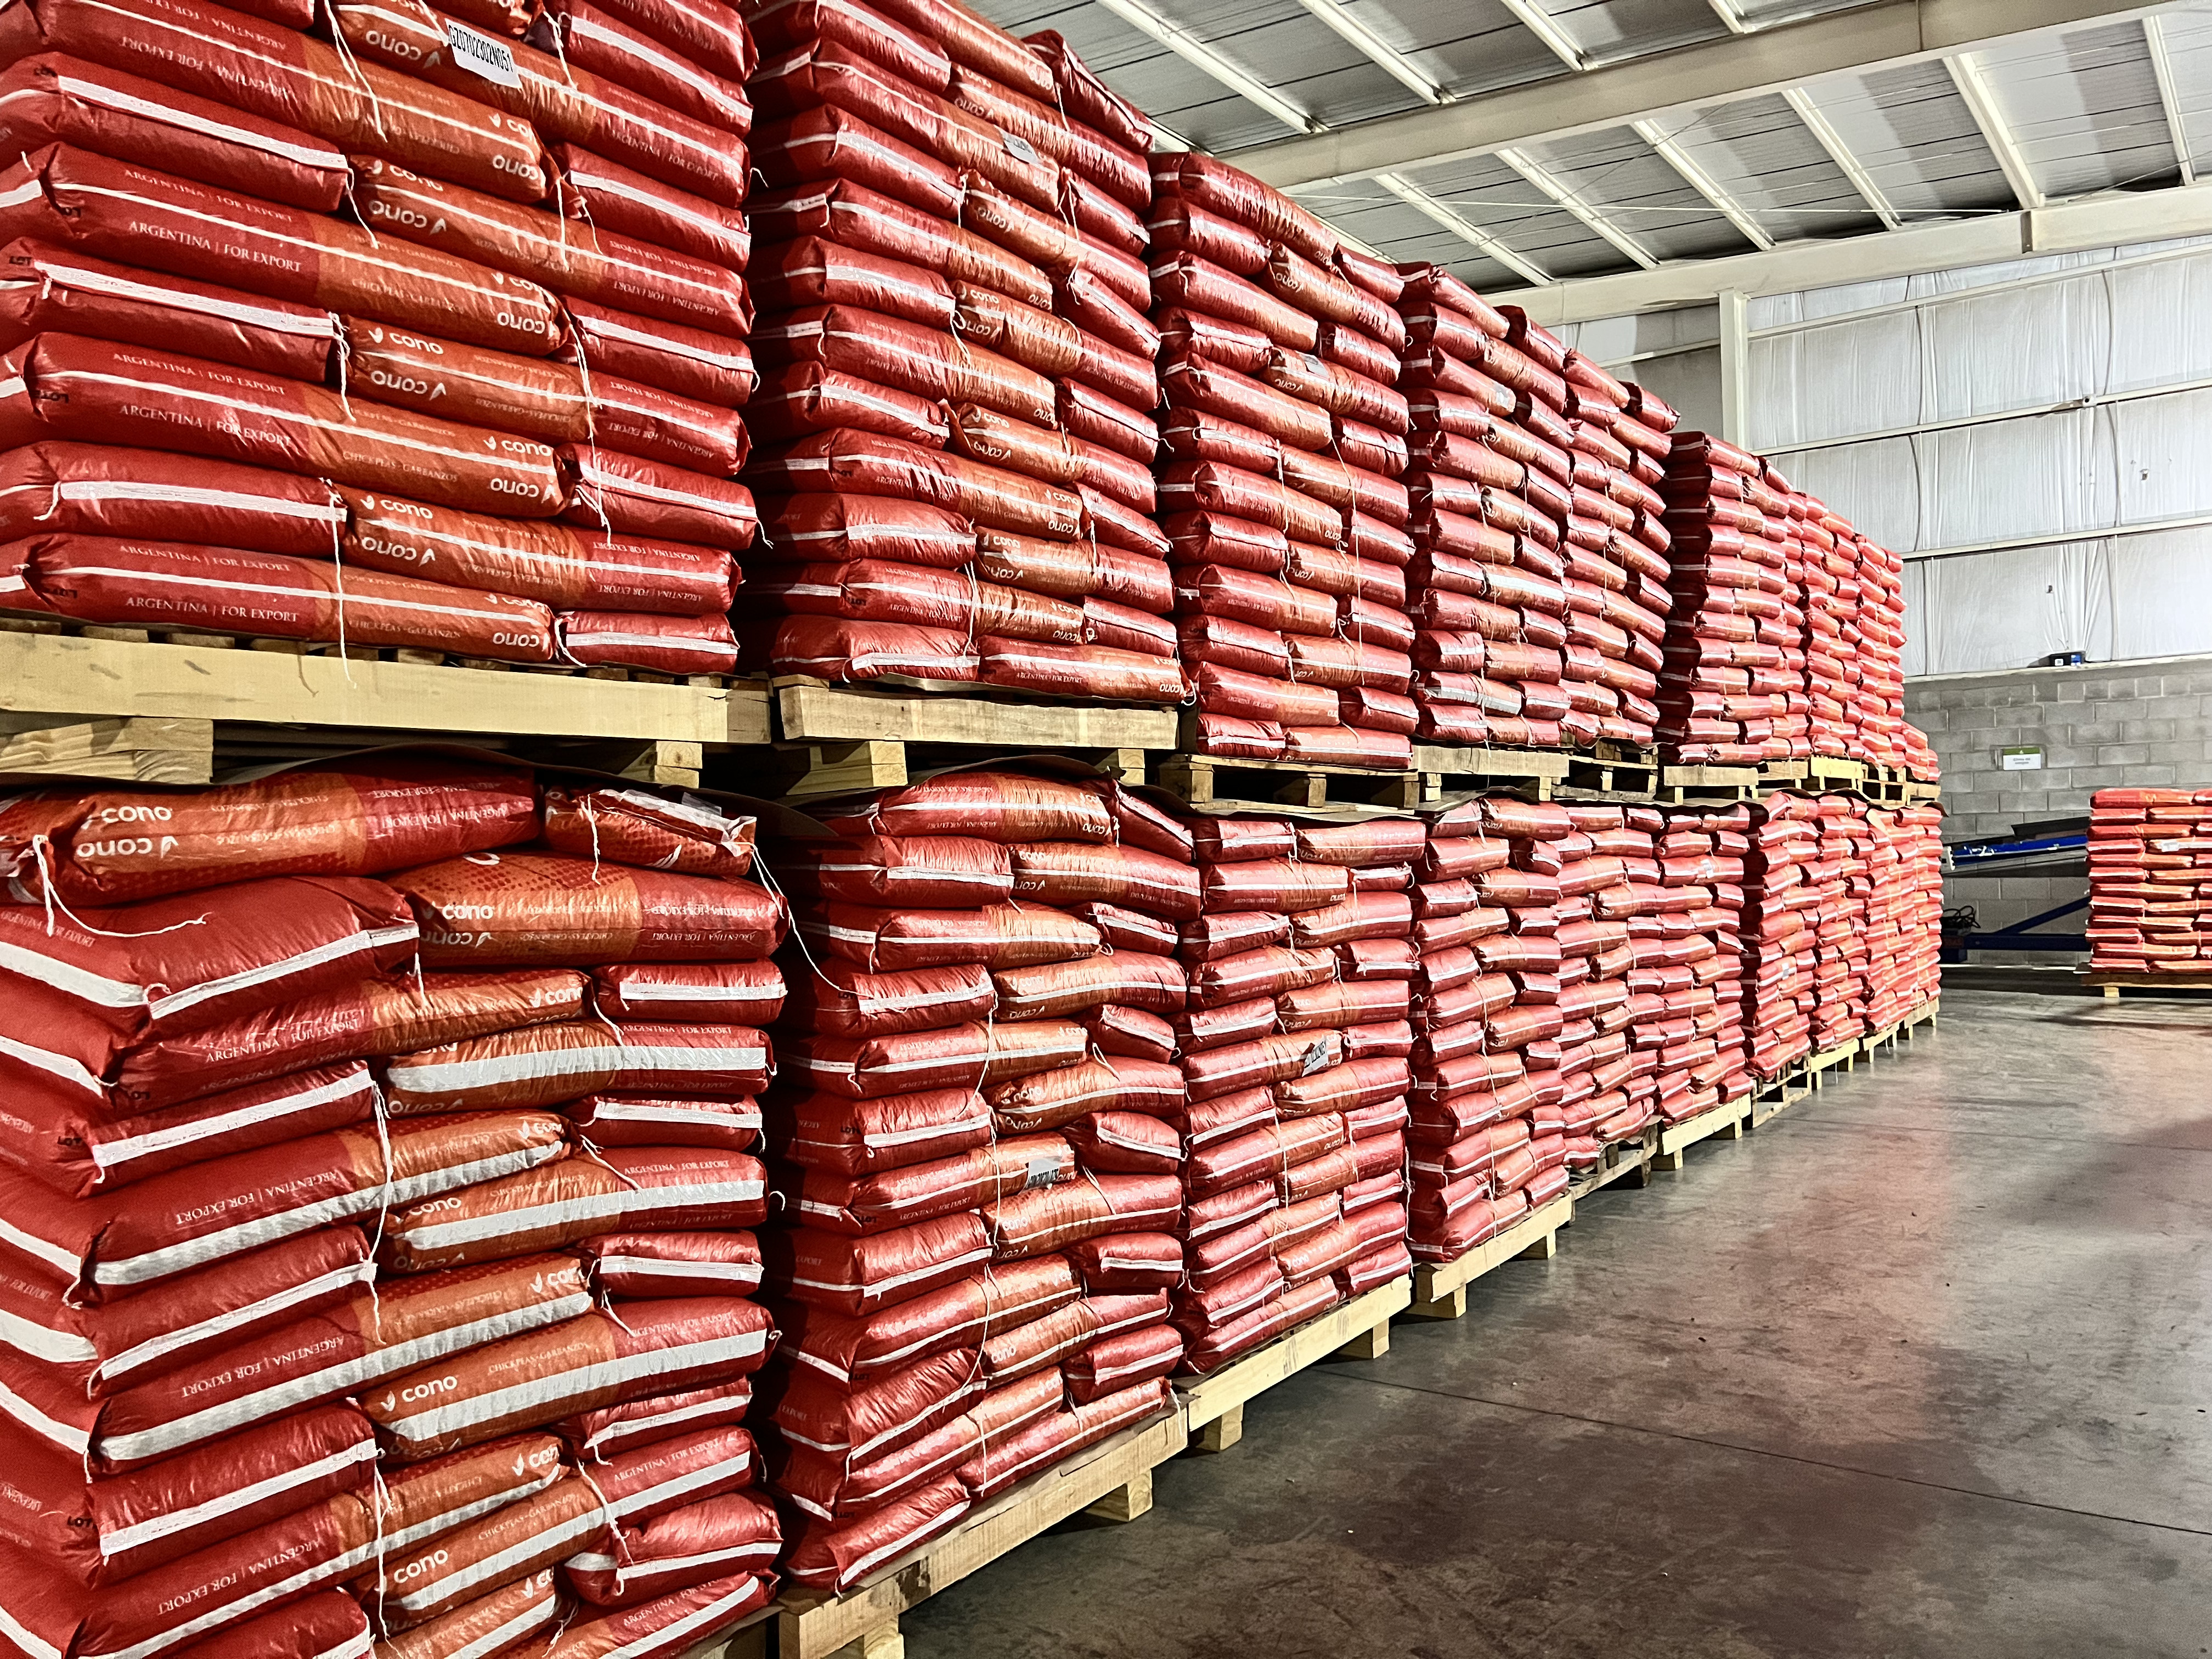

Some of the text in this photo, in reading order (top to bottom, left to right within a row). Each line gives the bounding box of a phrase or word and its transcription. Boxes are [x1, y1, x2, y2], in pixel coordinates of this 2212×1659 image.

[120, 36, 173, 60] EXPORT
[366, 30, 422, 60] cono
[177, 55, 203, 70] FOR
[493, 155, 539, 180] cono
[125, 170, 291, 222] ARGENTINA FOR EXPORT
[369, 200, 427, 228] cono
[978, 207, 1006, 228] cono
[128, 221, 301, 272] ARGENTINA FOR EXPORT
[498, 312, 545, 334] cono
[390, 332, 444, 354] cono
[114, 353, 285, 394] ARGENTINA FOR EXPORT
[371, 370, 428, 394] cono
[611, 381, 644, 397] EXPORT
[120, 405, 291, 447] ARGENTINA FOR EXPORT
[607, 422, 640, 437] EXPORT
[501, 440, 551, 456] cono
[667, 437, 714, 458] ARGENTINA
[490, 478, 539, 497] cono
[1053, 492, 1079, 506] cono
[380, 499, 433, 519] cono
[1048, 521, 1074, 534] cono
[362, 537, 417, 561] cono
[629, 545, 646, 554] FOR
[993, 536, 1021, 549] cono
[120, 545, 290, 572] ARGENTINA FOR EXPORT
[652, 549, 700, 561] ARGENTINA
[599, 585, 703, 602] ARGENTINA FOR EXPORT
[127, 597, 300, 623] ARGENTINA FOR EXPORT
[493, 632, 539, 647] cono
[1053, 630, 1079, 642] cono
[1159, 684, 1180, 693] cono
[101, 806, 172, 823] cono
[1082, 823, 1105, 834] cono
[77, 838, 153, 857] cono
[442, 905, 493, 919] cono
[653, 933, 755, 941] ARGENTINA FOR EXPORT
[1019, 975, 1045, 988] cono
[1010, 1010, 1036, 1019] cono
[623, 1025, 731, 1035] ARGENTINA FOR EXPORT
[206, 1040, 279, 1063] ARGENTINA
[625, 1160, 730, 1175] ARGENTINA FOR EXPORT
[176, 1170, 338, 1224] ARGENTINA FOR EXPORT
[409, 1197, 461, 1215] cono
[1002, 1217, 1028, 1231] cono
[701, 1312, 732, 1323] EXPORT
[991, 1346, 1017, 1364] cono
[182, 1336, 343, 1397] ARGENTINA FOR EXPORT
[402, 1376, 458, 1402] cono
[614, 1438, 720, 1481] ARGENTINA FOR EXPORT
[394, 1549, 448, 1583] cono
[158, 1539, 322, 1616] ARGENTINA FOR EXPORT
[623, 1599, 674, 1627] ARGENTINA
